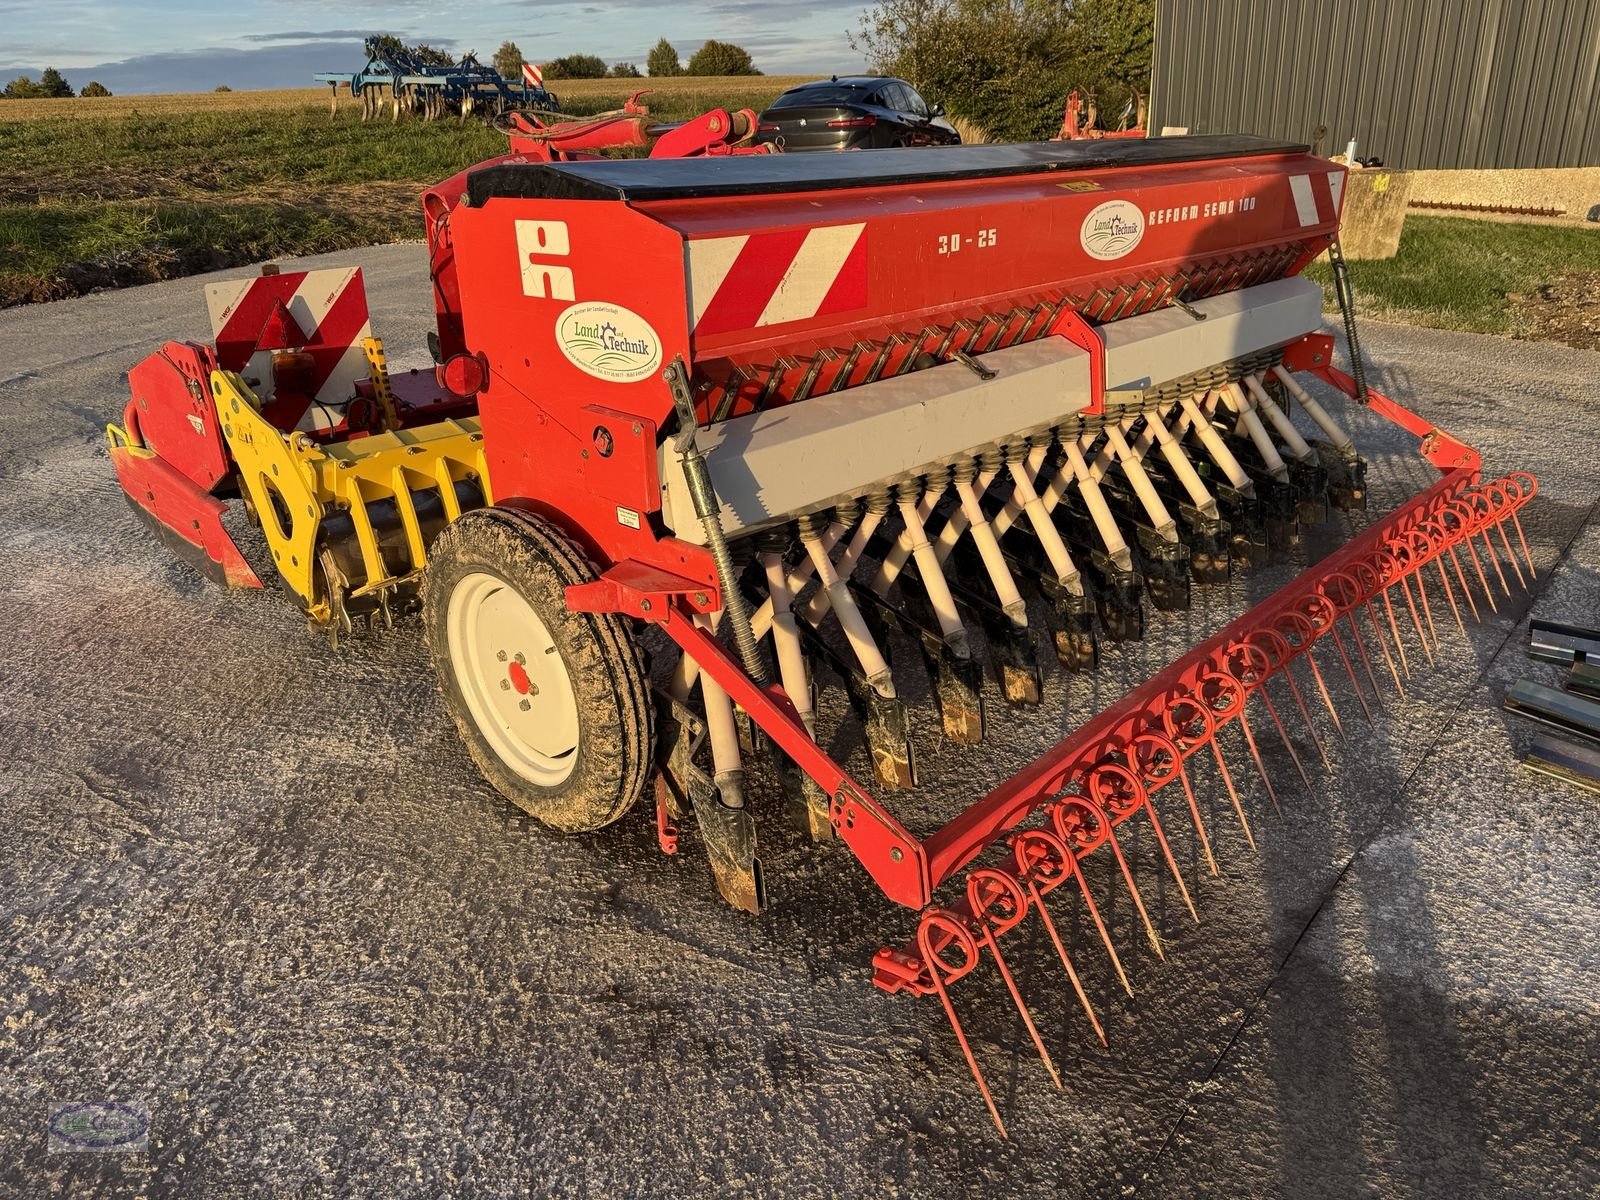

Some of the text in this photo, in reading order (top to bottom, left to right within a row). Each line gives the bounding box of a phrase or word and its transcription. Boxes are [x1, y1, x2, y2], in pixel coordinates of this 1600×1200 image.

[1149, 205, 1199, 226] REFORM
[1239, 197, 1256, 212] 100
[1094, 217, 1112, 231] Land
[1115, 223, 1138, 236] Technik
[978, 228, 997, 248] 25
[574, 321, 600, 339] Land
[608, 336, 650, 355] Technik
